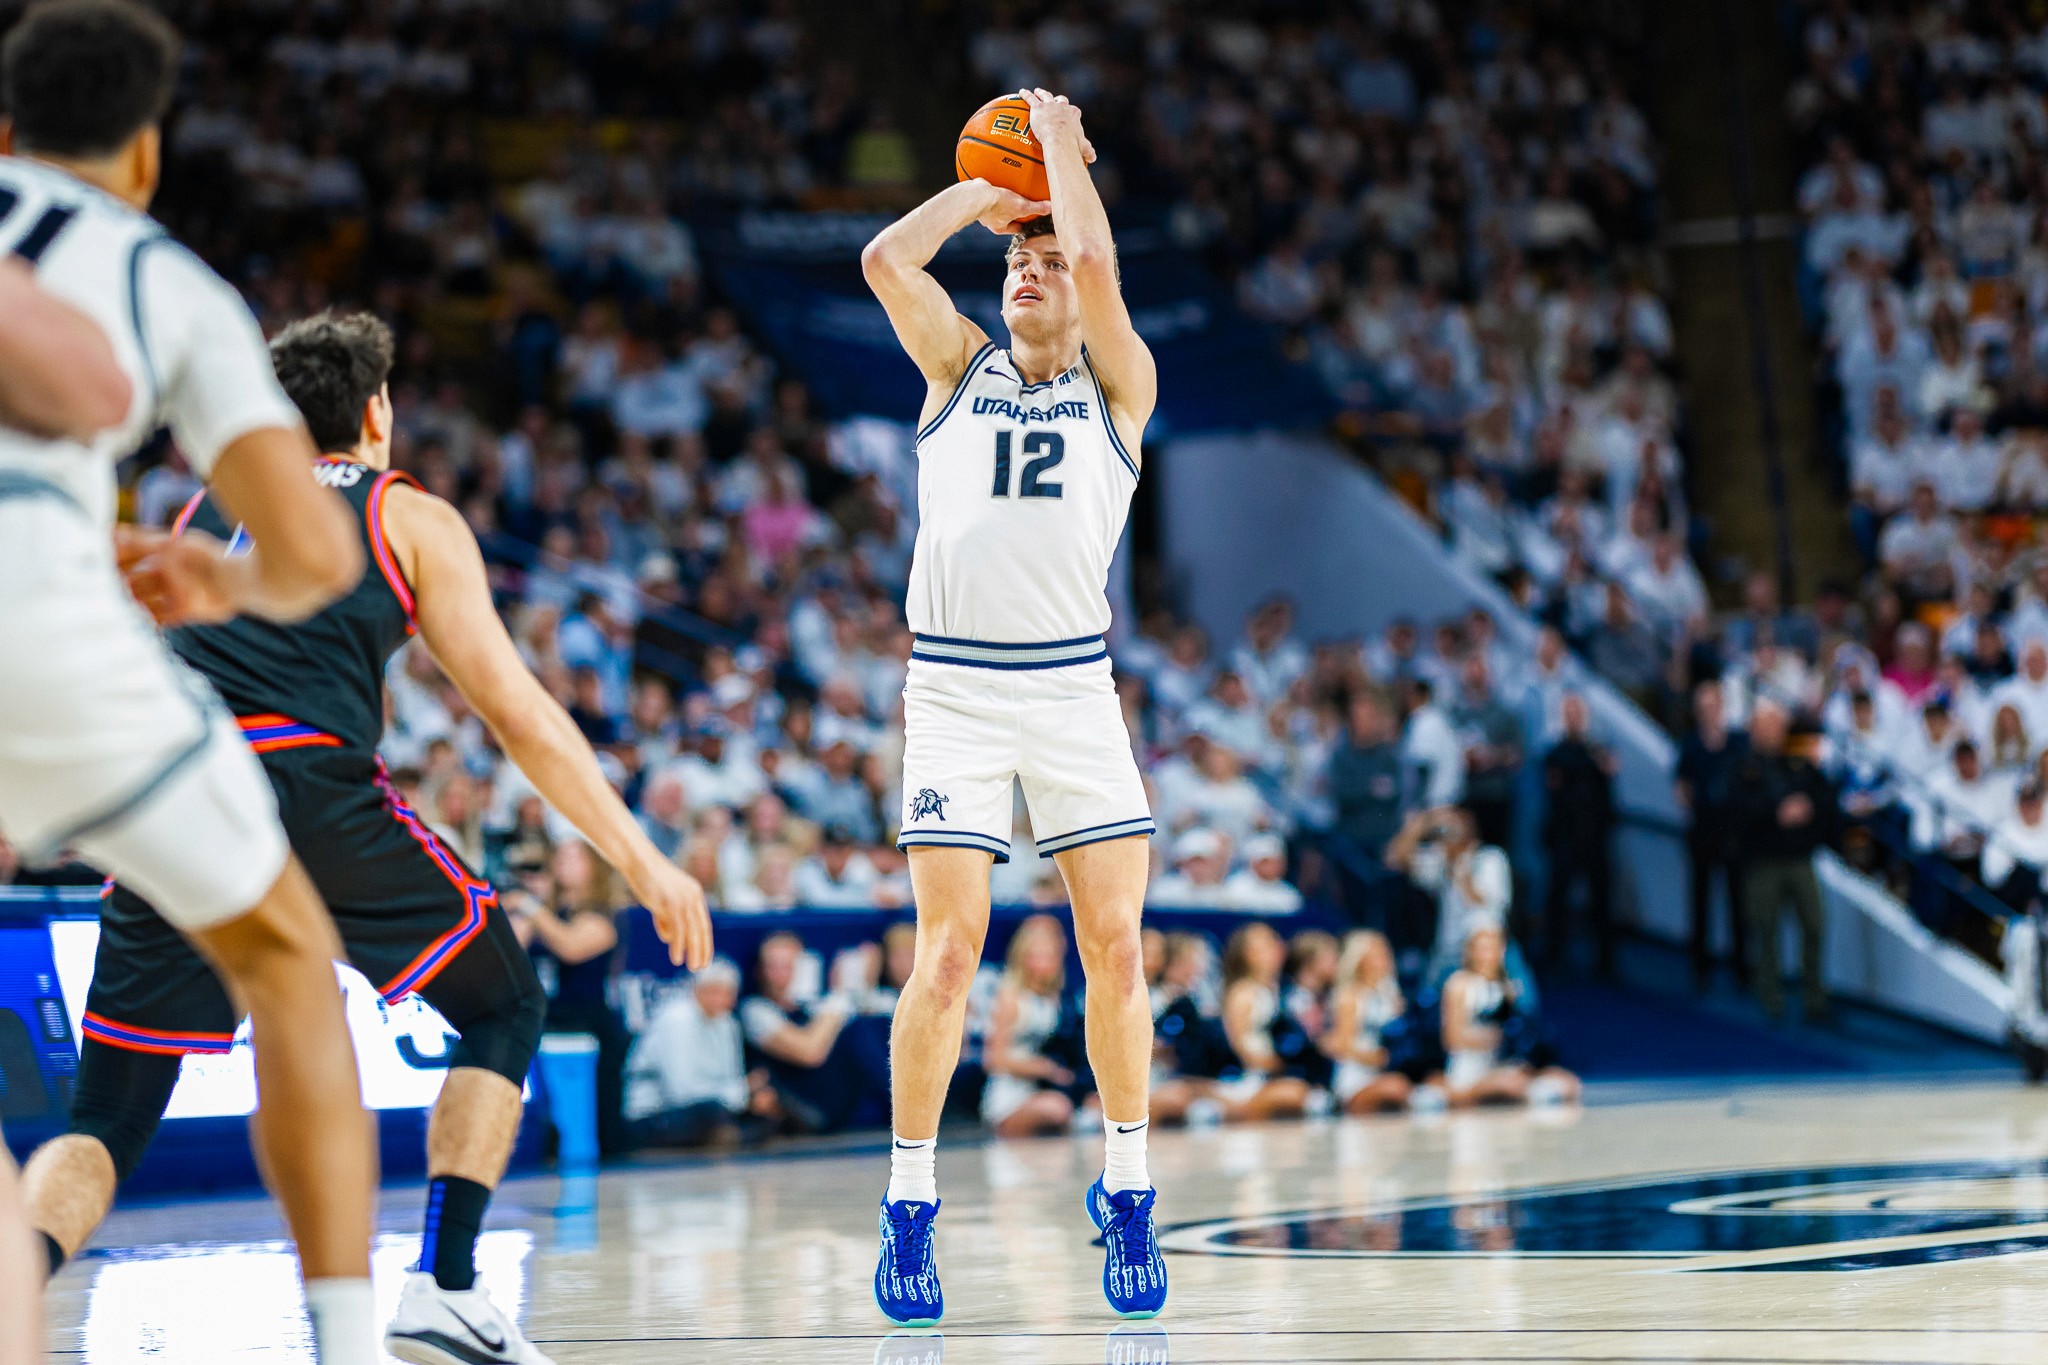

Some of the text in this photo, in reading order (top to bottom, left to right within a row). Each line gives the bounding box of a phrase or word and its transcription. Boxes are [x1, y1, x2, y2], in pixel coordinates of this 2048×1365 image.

[992, 114, 1031, 138] ELI
[972, 396, 1089, 426] UTAH STATE
[991, 429, 1067, 500] 12
